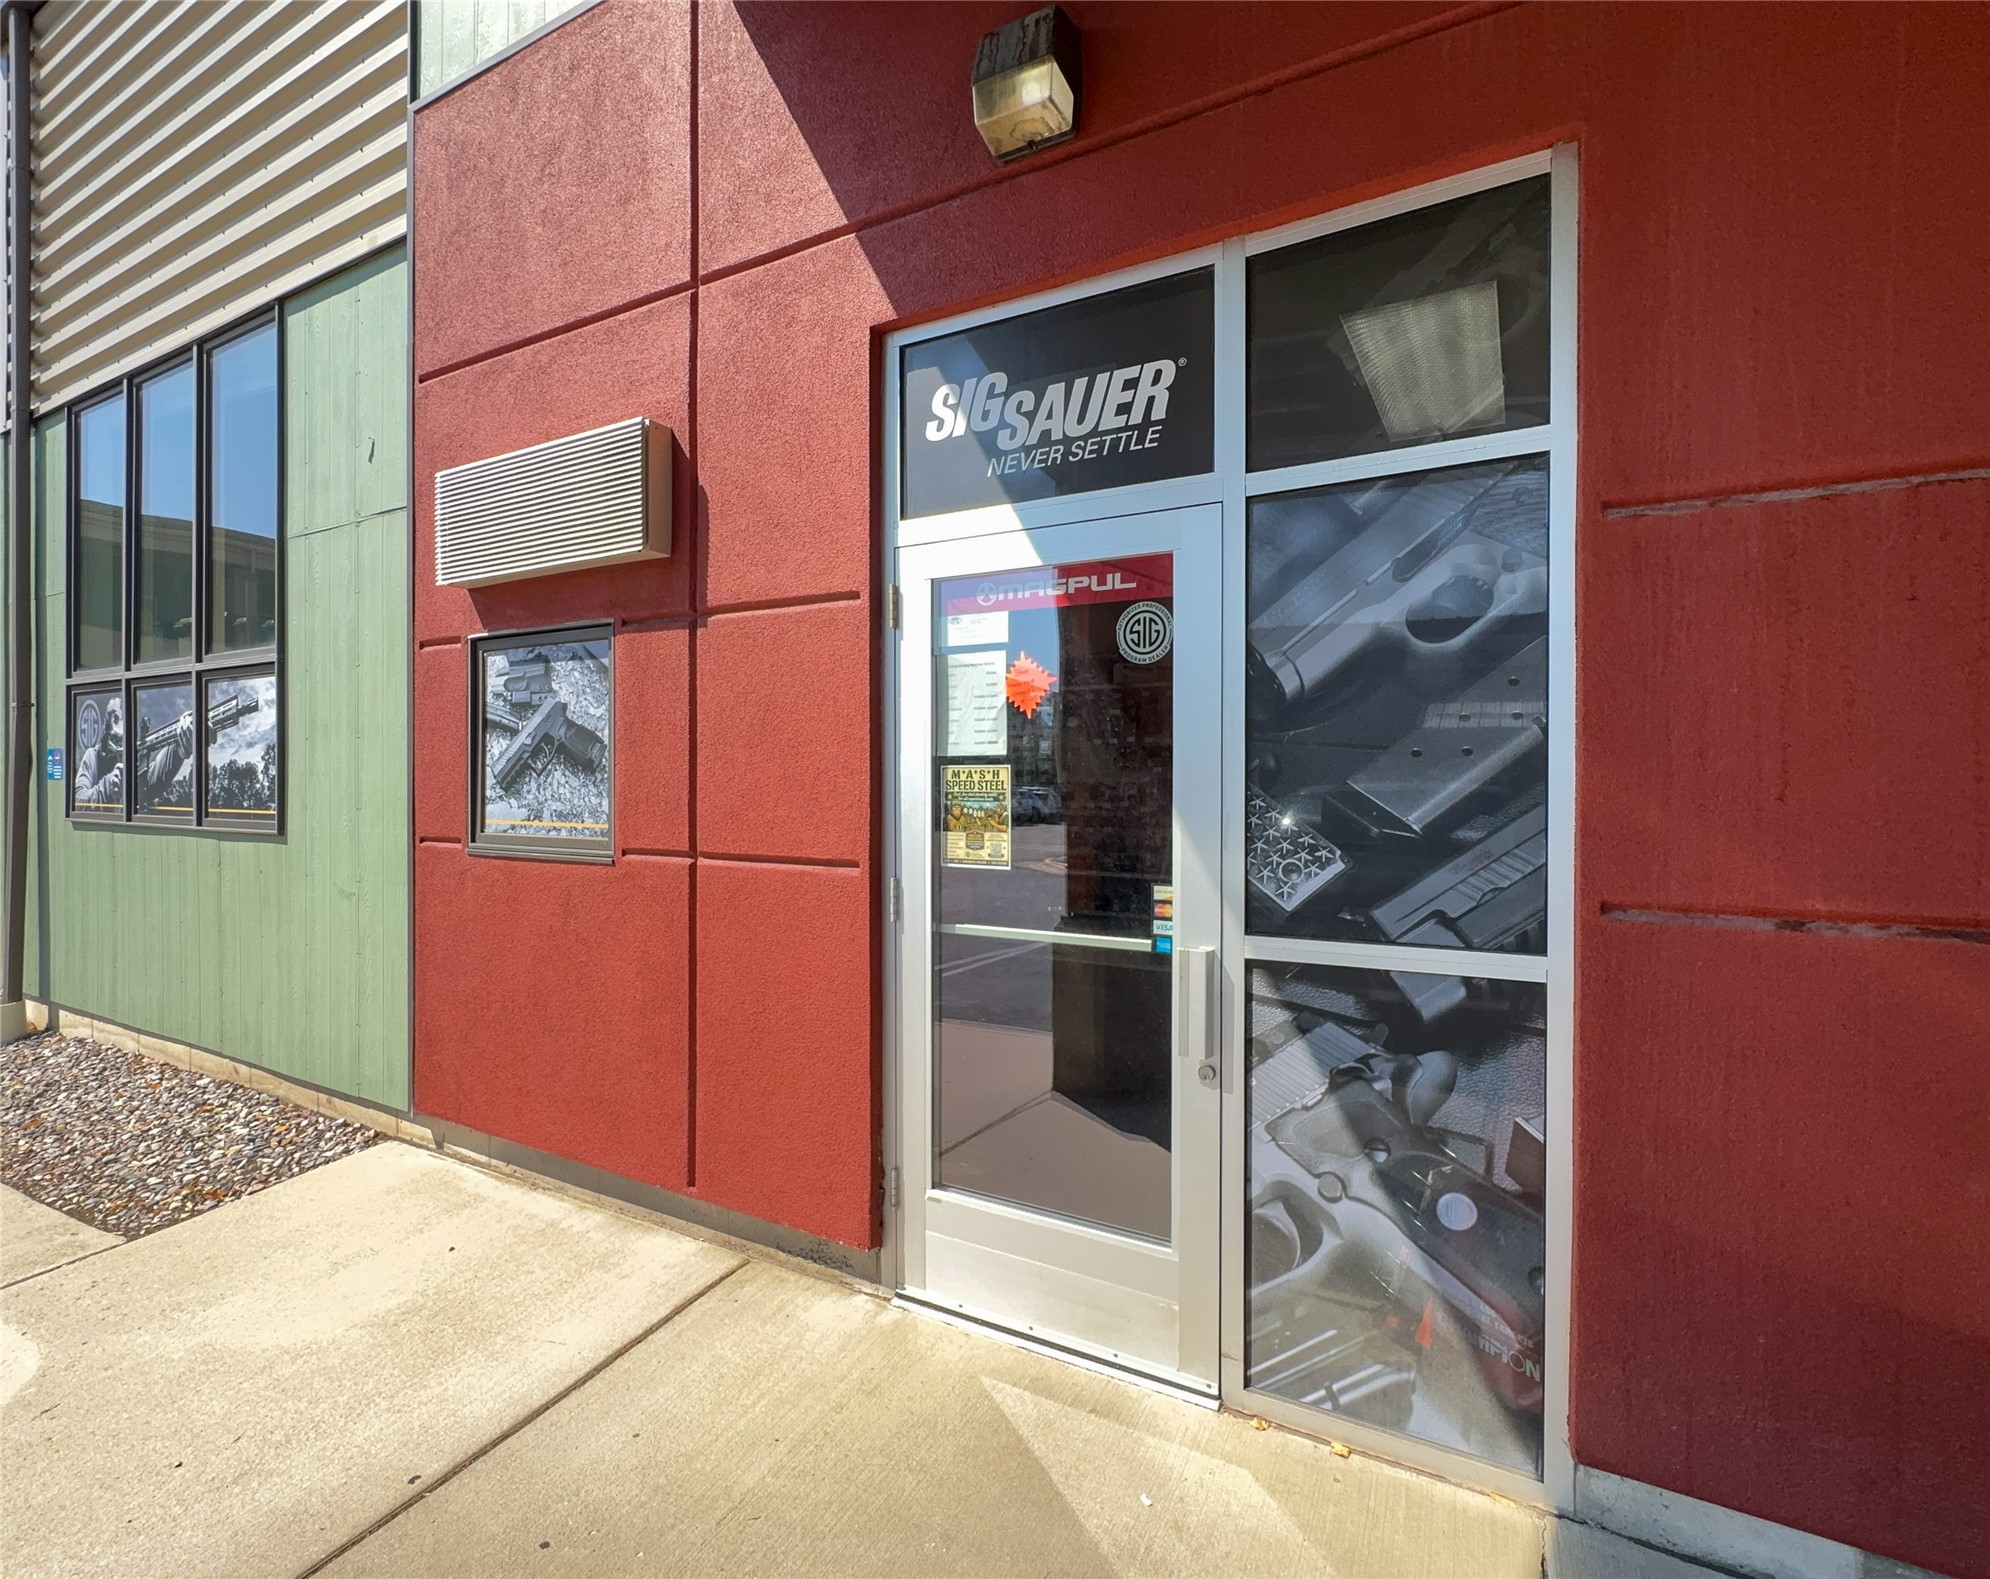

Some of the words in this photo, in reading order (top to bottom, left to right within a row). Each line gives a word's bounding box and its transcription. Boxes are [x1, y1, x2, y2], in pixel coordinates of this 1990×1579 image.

[925, 372, 1008, 442] SIG
[996, 359, 1177, 451] SAUER
[987, 446, 1064, 477] NEVER
[1068, 425, 1163, 462] SETTLE
[998, 572, 1137, 601] MAGPUL
[1117, 604, 1142, 631] AUTHORIZED
[1141, 602, 1174, 627] PROFESSIONAL
[1129, 616, 1161, 649] SIG
[1121, 647, 1148, 663] PROGRAM
[1147, 645, 1169, 662] DEALER
[81, 707, 99, 747] SIG
[945, 779, 976, 791] SPEED
[977, 779, 1007, 791] STEEL
[1155, 924, 1174, 932] VISA
